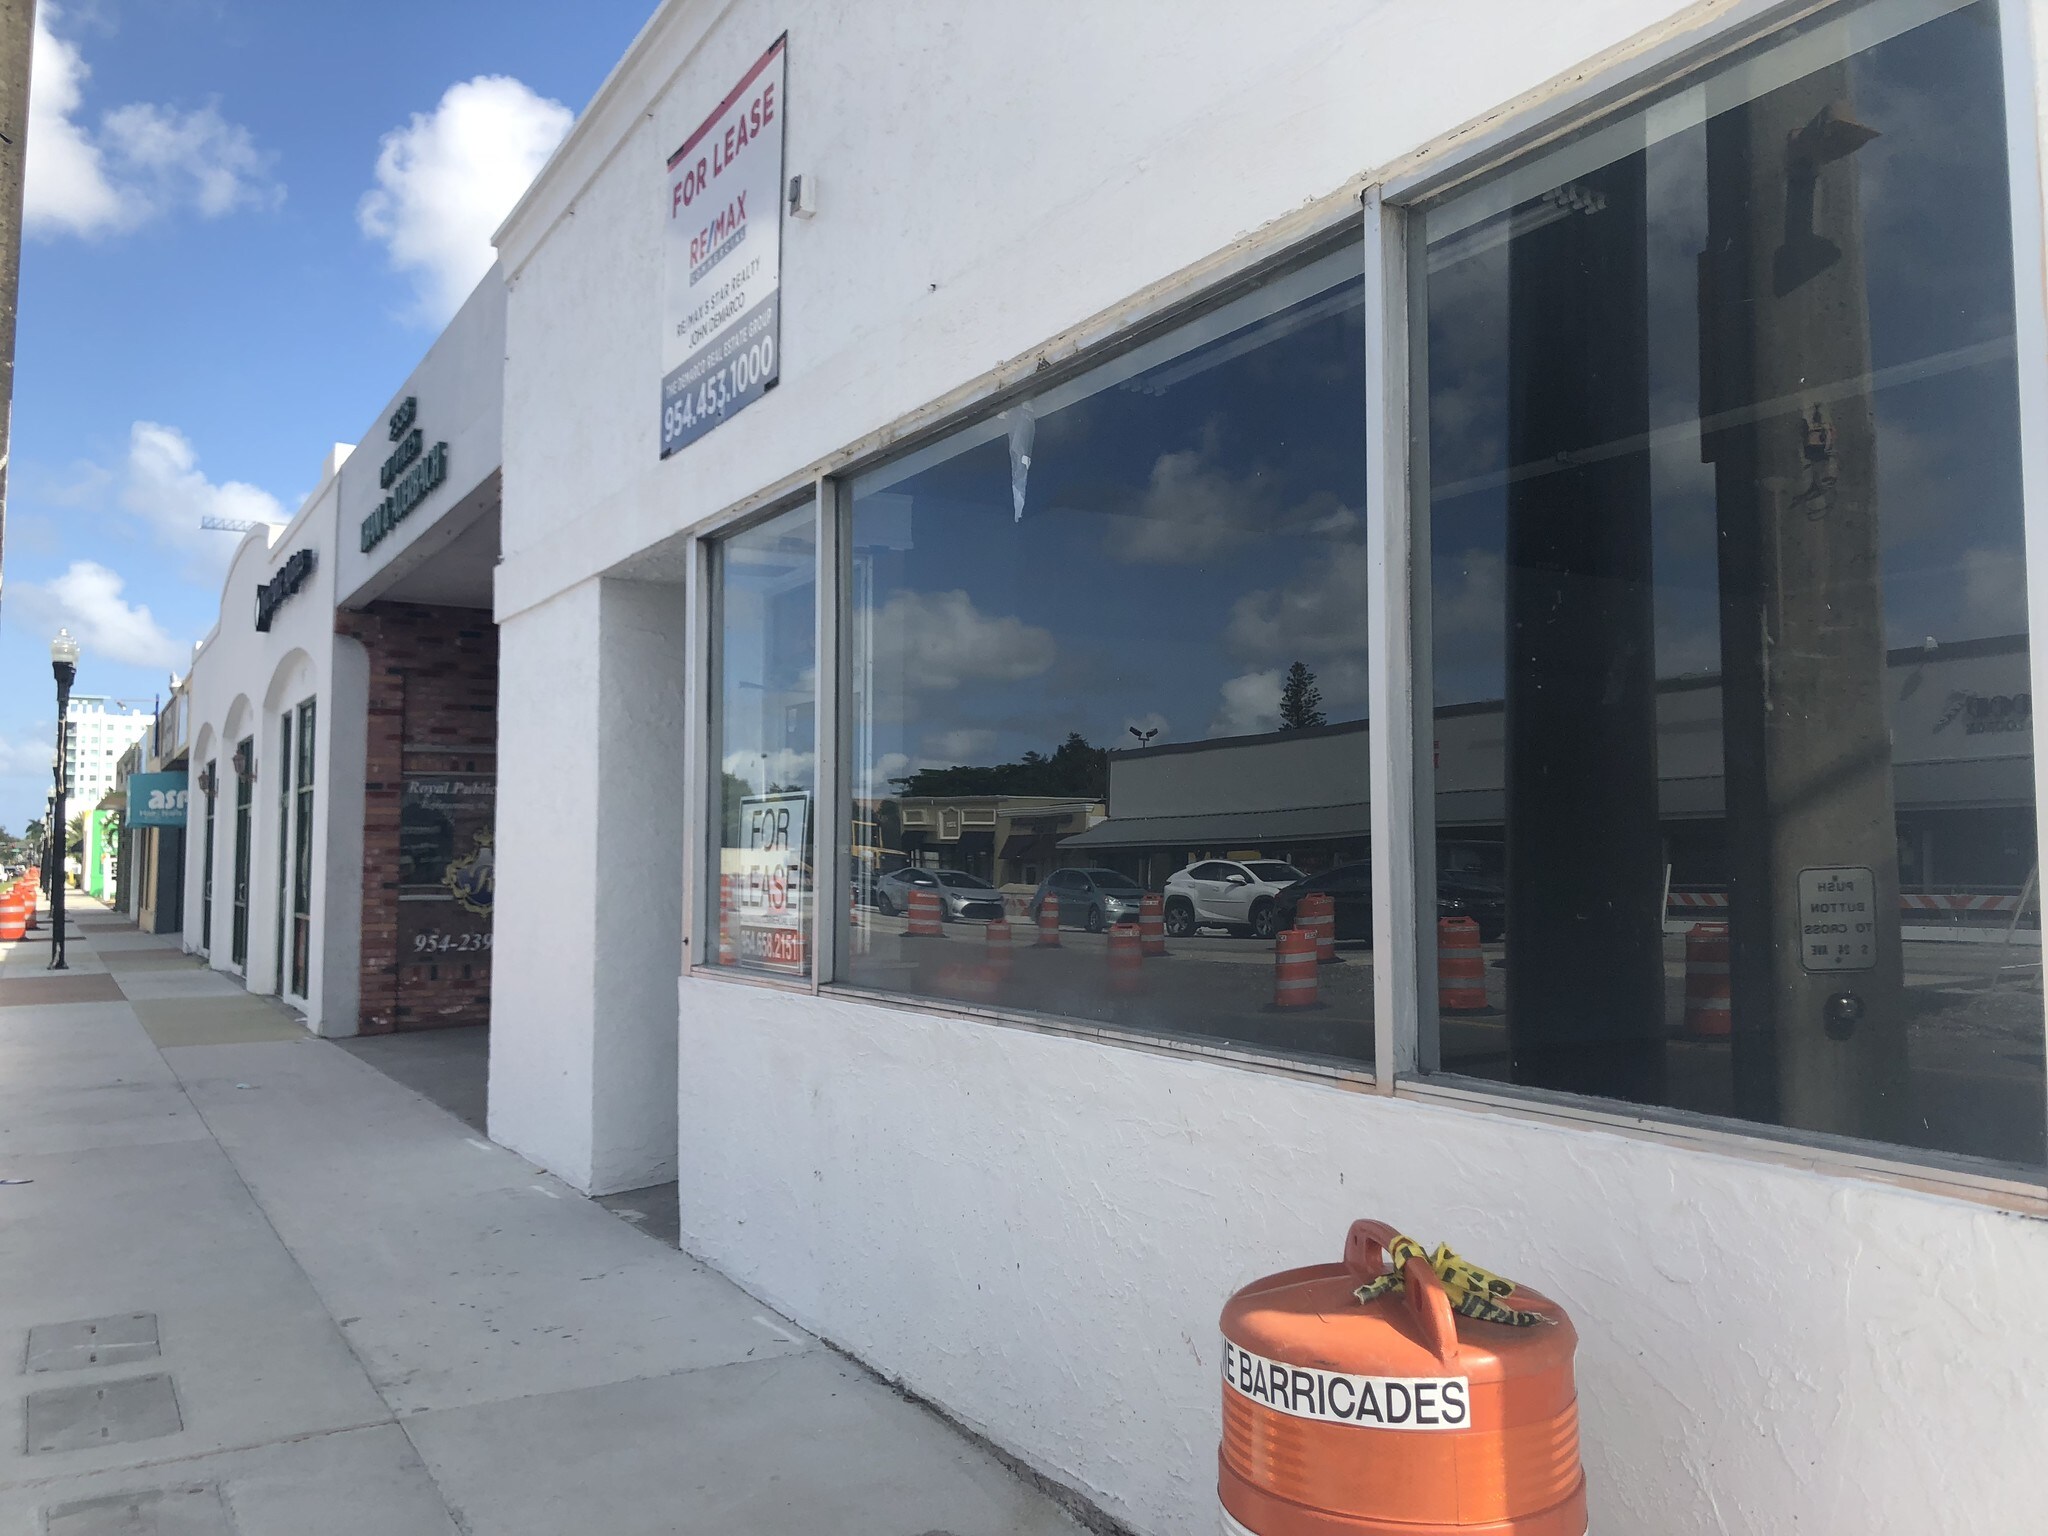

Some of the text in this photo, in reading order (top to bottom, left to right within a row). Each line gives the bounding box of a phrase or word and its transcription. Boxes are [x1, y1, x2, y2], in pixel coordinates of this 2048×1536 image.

[672, 82, 774, 219] FOR LEASE
[689, 190, 746, 268] RE/MAX
[710, 284, 729, 310] STAR
[731, 257, 760, 290] REALTY
[749, 308, 771, 335] GROUP
[663, 335, 773, 443] 954.453.1000
[409, 781, 450, 796] Royal
[751, 808, 790, 851] FOR
[742, 864, 798, 909] LEASE
[1239, 1349, 1467, 1425] BARRICADES
